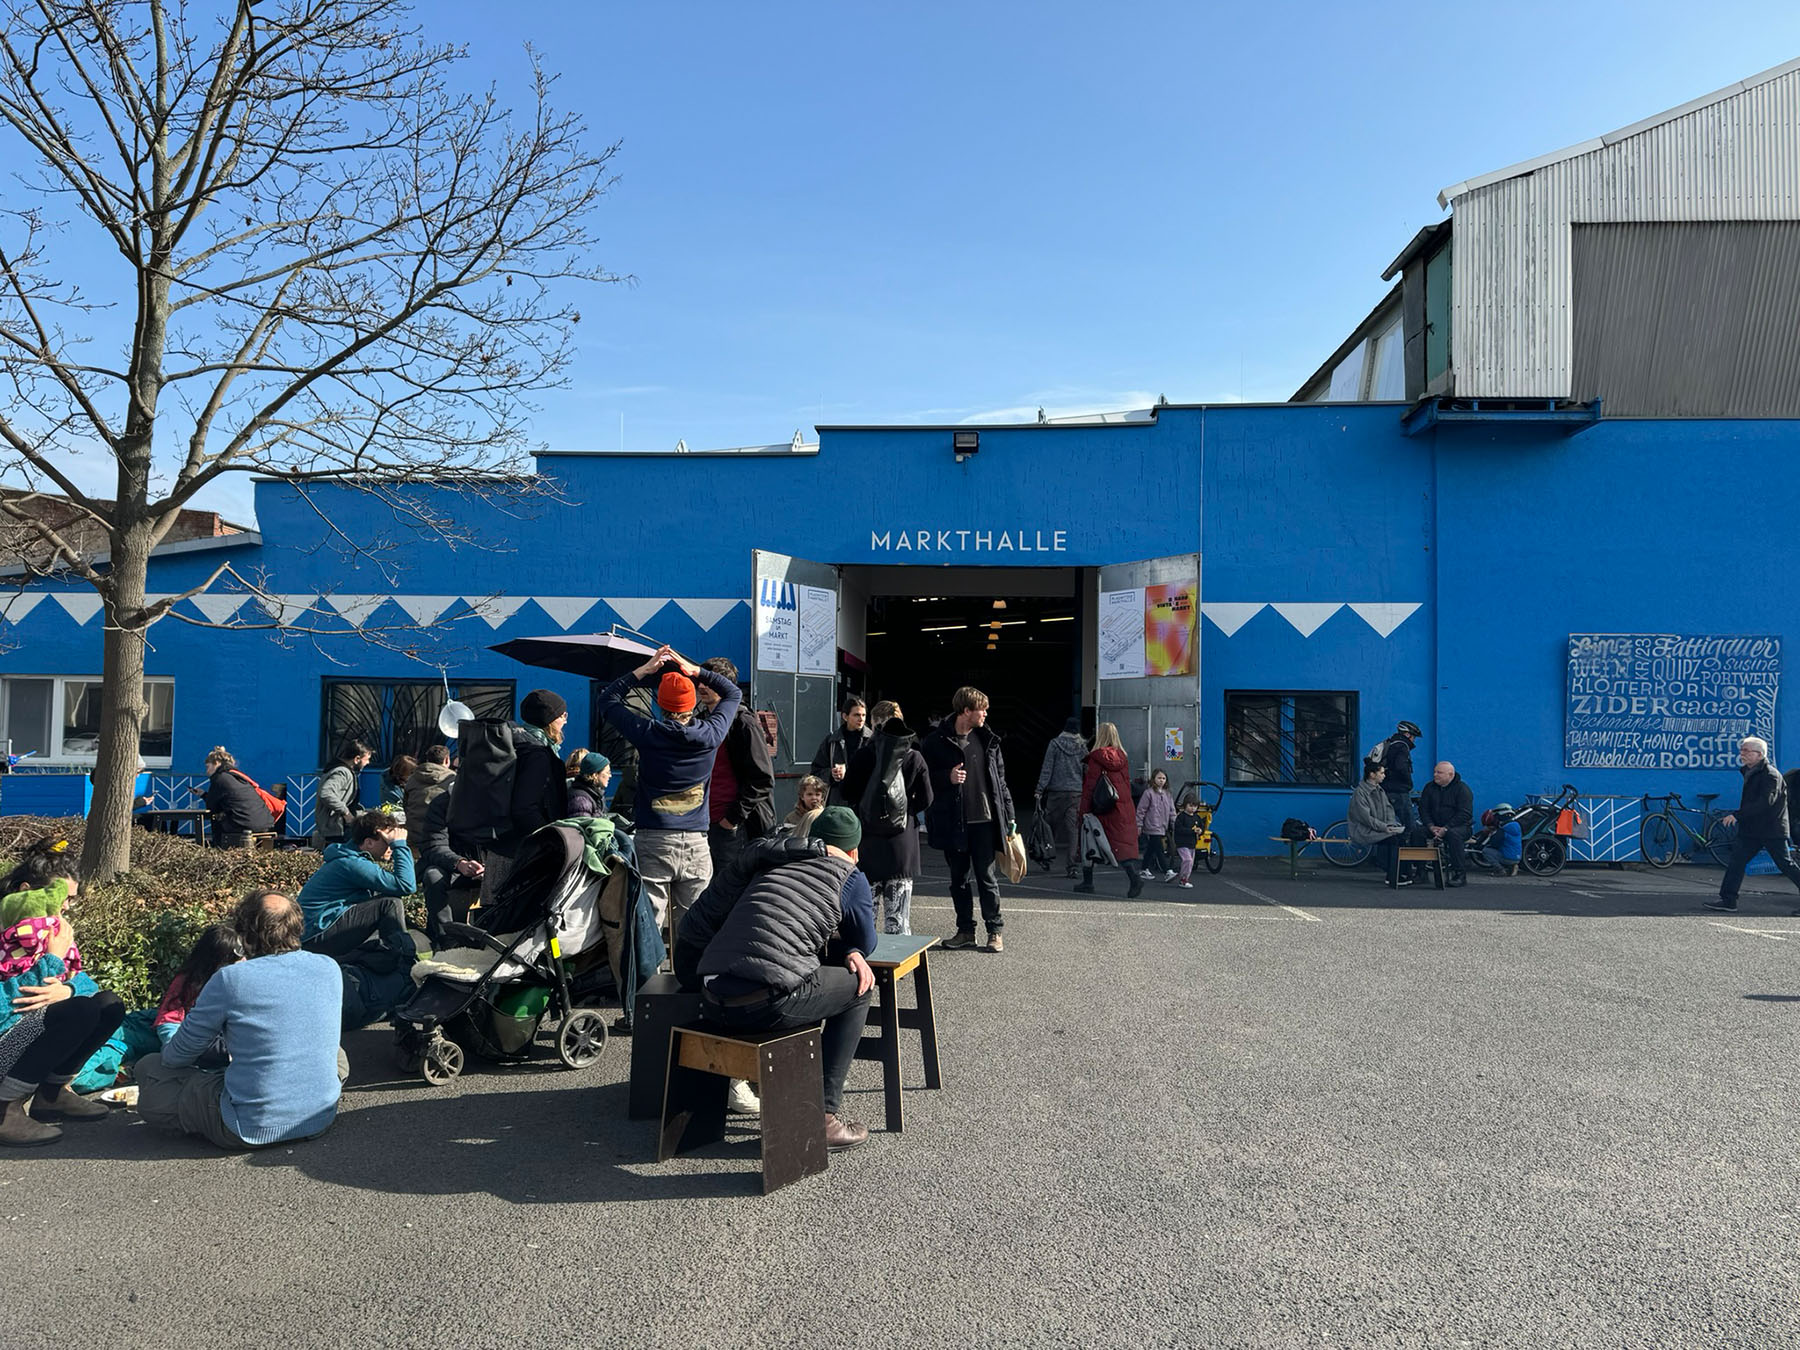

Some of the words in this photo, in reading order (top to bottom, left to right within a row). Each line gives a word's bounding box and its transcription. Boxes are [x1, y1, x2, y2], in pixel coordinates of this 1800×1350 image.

[871, 530, 1067, 551] MARKTHALLE
[765, 616, 792, 625] SAMSTAG
[1634, 638, 1651, 680] KR/23
[1700, 671, 1780, 686] PORTWEIN
[1571, 695, 1672, 716] ZIDER
[1571, 714, 1662, 731] Schnäpse
[1661, 717, 1719, 732] LEIPZIGER
[1719, 718, 1751, 733] MEHL
[1569, 731, 1641, 749] PLAGWITZER
[1643, 732, 1683, 750] HONIG
